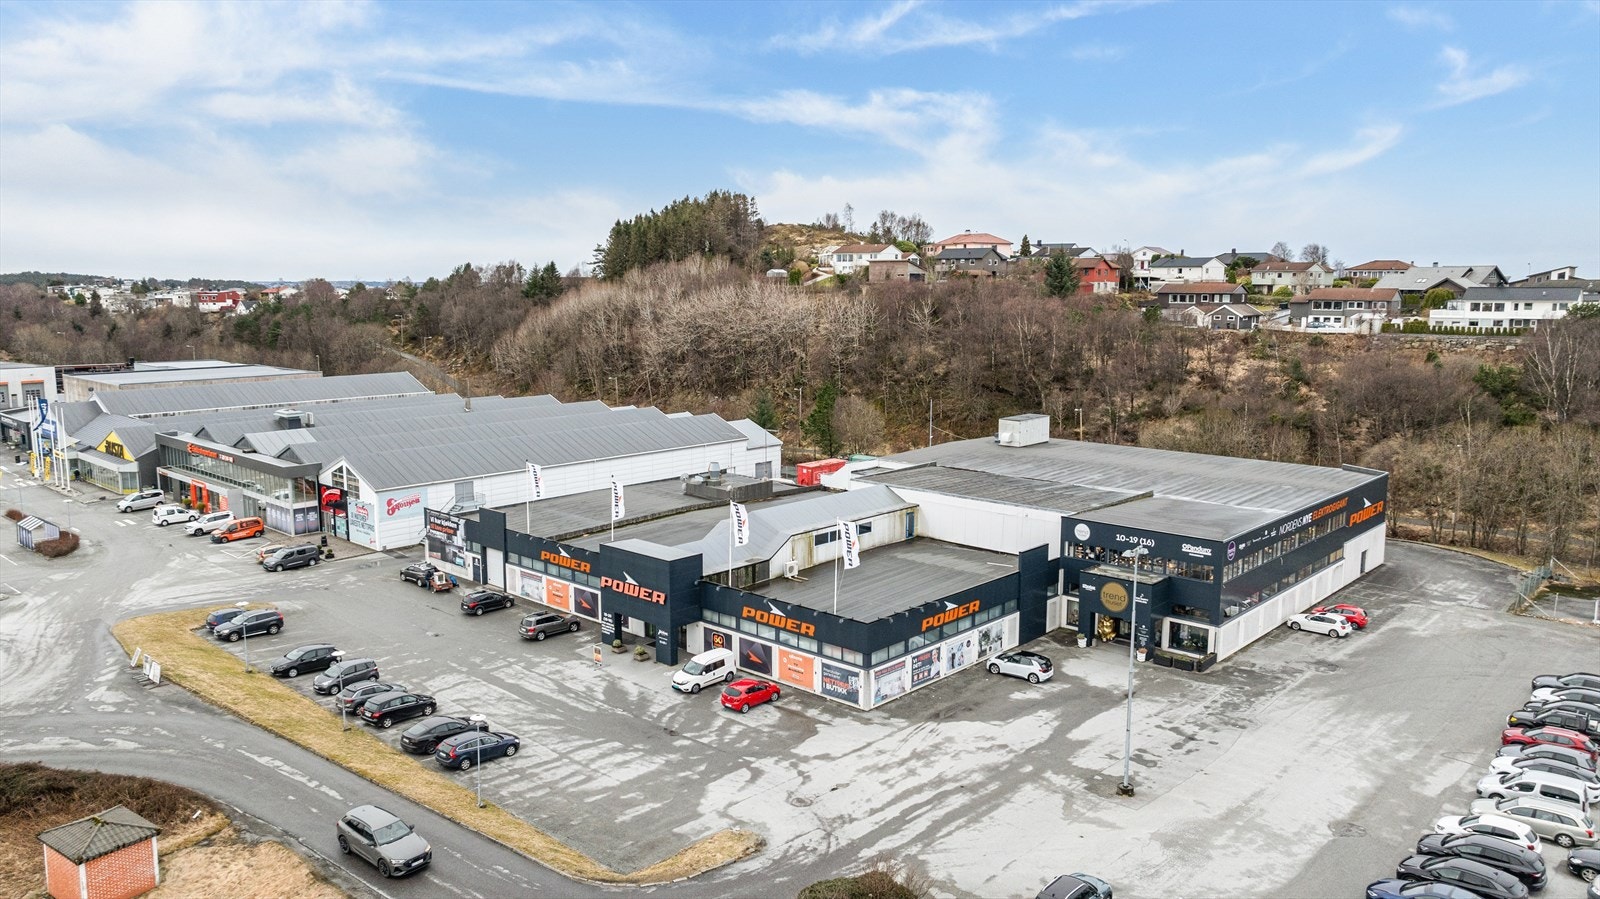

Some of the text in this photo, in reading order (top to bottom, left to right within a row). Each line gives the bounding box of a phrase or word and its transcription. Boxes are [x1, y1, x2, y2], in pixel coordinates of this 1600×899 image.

[733, 503, 743, 544] POWER
[1278, 517, 1303, 535] NORDENS
[1349, 500, 1384, 527] POWER
[843, 522, 853, 567] POWER
[1116, 534, 1155, 547] 10-19 (16)
[540, 550, 591, 573] POWER
[601, 576, 666, 605] POWER
[1103, 591, 1126, 602] trend
[741, 606, 816, 637] POWER
[921, 600, 981, 632] POWER
